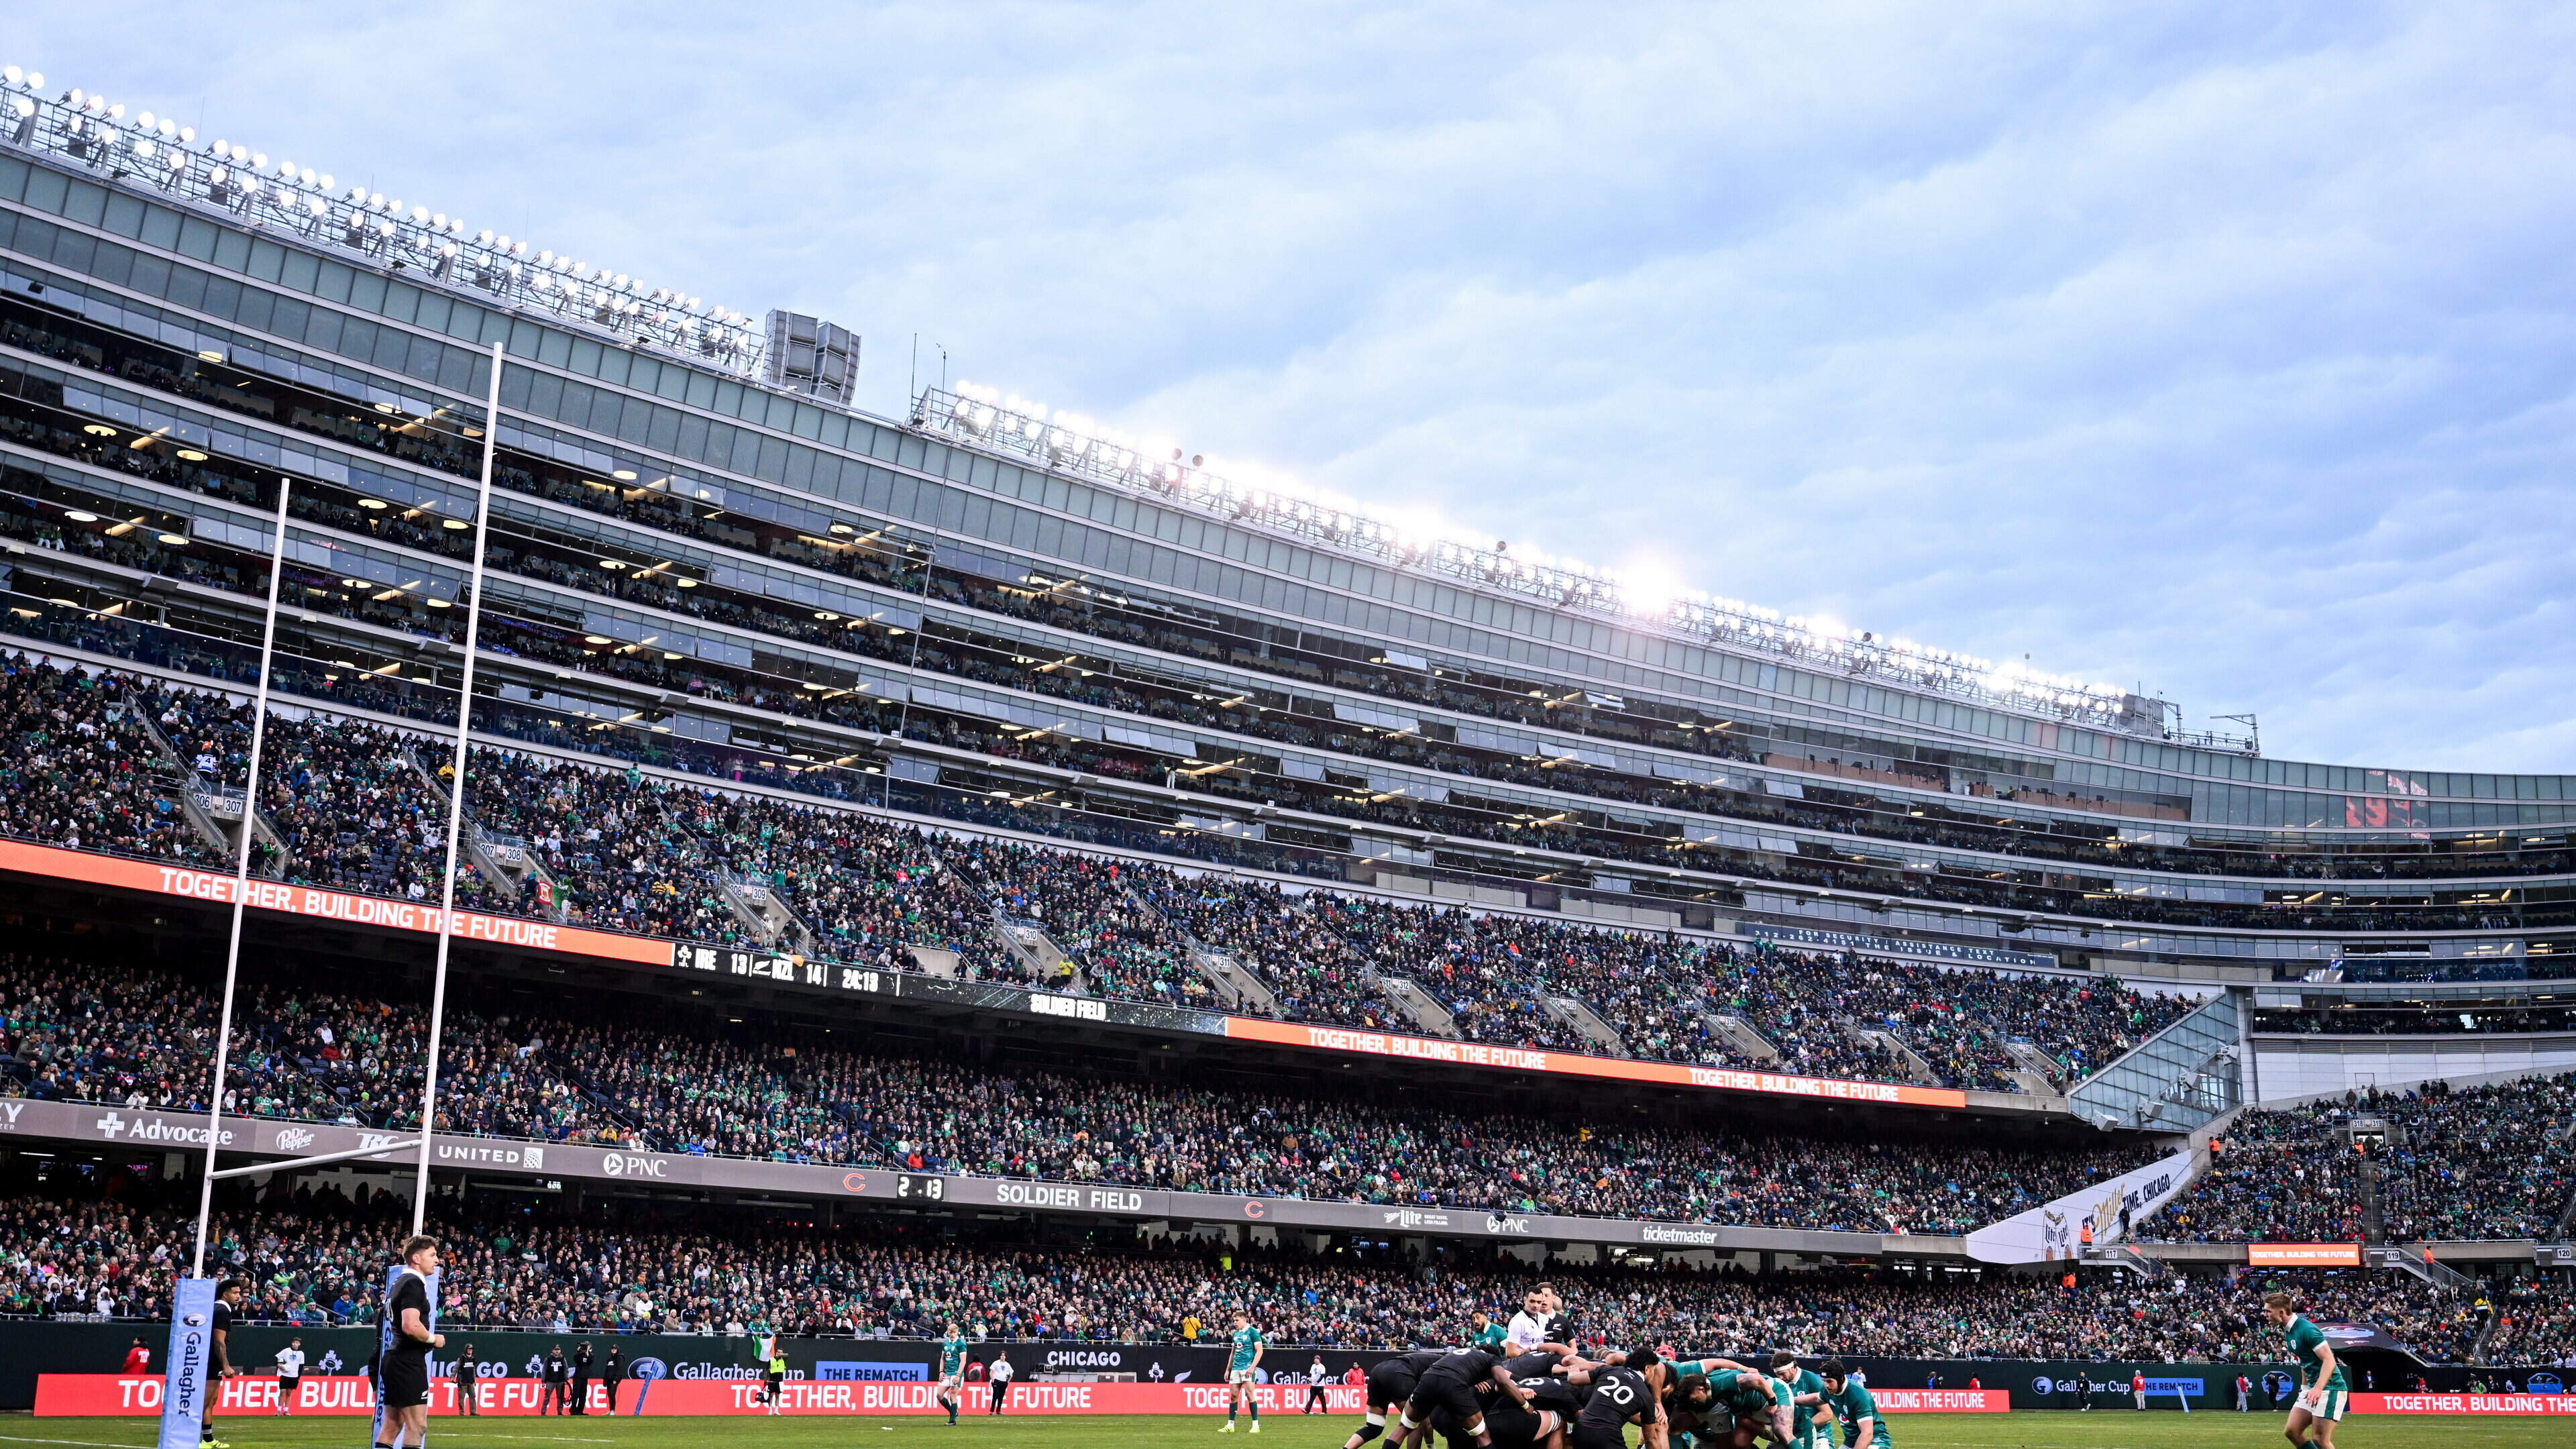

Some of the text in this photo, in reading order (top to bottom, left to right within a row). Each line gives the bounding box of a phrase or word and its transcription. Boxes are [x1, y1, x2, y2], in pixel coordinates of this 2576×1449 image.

[225, 799, 241, 813] 307
[507, 849, 521, 860] 308
[754, 888, 765, 899] 309
[160, 867, 297, 913] TOGETHER,
[305, 891, 415, 925] BUILDING
[470, 916, 557, 949] FUTURE
[1026, 930, 1036, 940] 310
[1826, 932, 1879, 943] SECURITY
[1895, 941, 1962, 953] ASSISTANCE
[1220, 957, 1230, 966] 311
[1900, 947, 1941, 955] ISSUE
[1968, 953, 2036, 965] LOCATION
[695, 948, 822, 985] IRE 13 NZL 14
[1399, 981, 1409, 989] 312
[1030, 993, 1107, 1021] SOLDIER FIELD
[1567, 1000, 1576, 1009] 313
[1308, 1028, 1546, 1070] TOGETHER, BUILDING THE FUTURE
[1689, 1067, 1899, 1102] TOGETHER, BUILDING THE FUTURE
[130, 1118, 233, 1145] Advocae
[276, 1128, 315, 1151] Pepper
[291, 1128, 307, 1138] Dr
[439, 1146, 519, 1163] UNITED
[626, 1157, 668, 1177] PNC
[2143, 1173, 2170, 1202] CHICAGO
[997, 1183, 1142, 1212] SOLDIER FIELD
[1399, 1210, 1422, 1228] Lite
[1503, 1217, 1529, 1233] PNC
[1642, 1226, 1717, 1244] ticketmaster
[2387, 1252, 2399, 1260] 119
[2559, 1249, 2571, 1257] 120
[1047, 1350, 1120, 1367] CHICAGO
[178, 1332, 201, 1417] Gallagher
[674, 1362, 763, 1381] Gallagher
[824, 1368, 919, 1381] THE REMATCH
[1273, 1371, 1339, 1385] Gallaer
[1597, 1375, 1634, 1405] 20
[2056, 1379, 2130, 1395] Gallher Cup
[2147, 1382, 2157, 1390] HE
[443, 1383, 496, 1408] TE
[731, 1385, 856, 1411] TOETHER,
[1013, 1386, 1091, 1409] FUTURE
[1183, 1387, 1279, 1411] TOGEER,
[1284, 1388, 1360, 1409] BUDING
[1873, 1392, 1986, 1409] BUILDING THE FUTURE
[2383, 1395, 2576, 1413] TOGETHER, BUILDING THE
